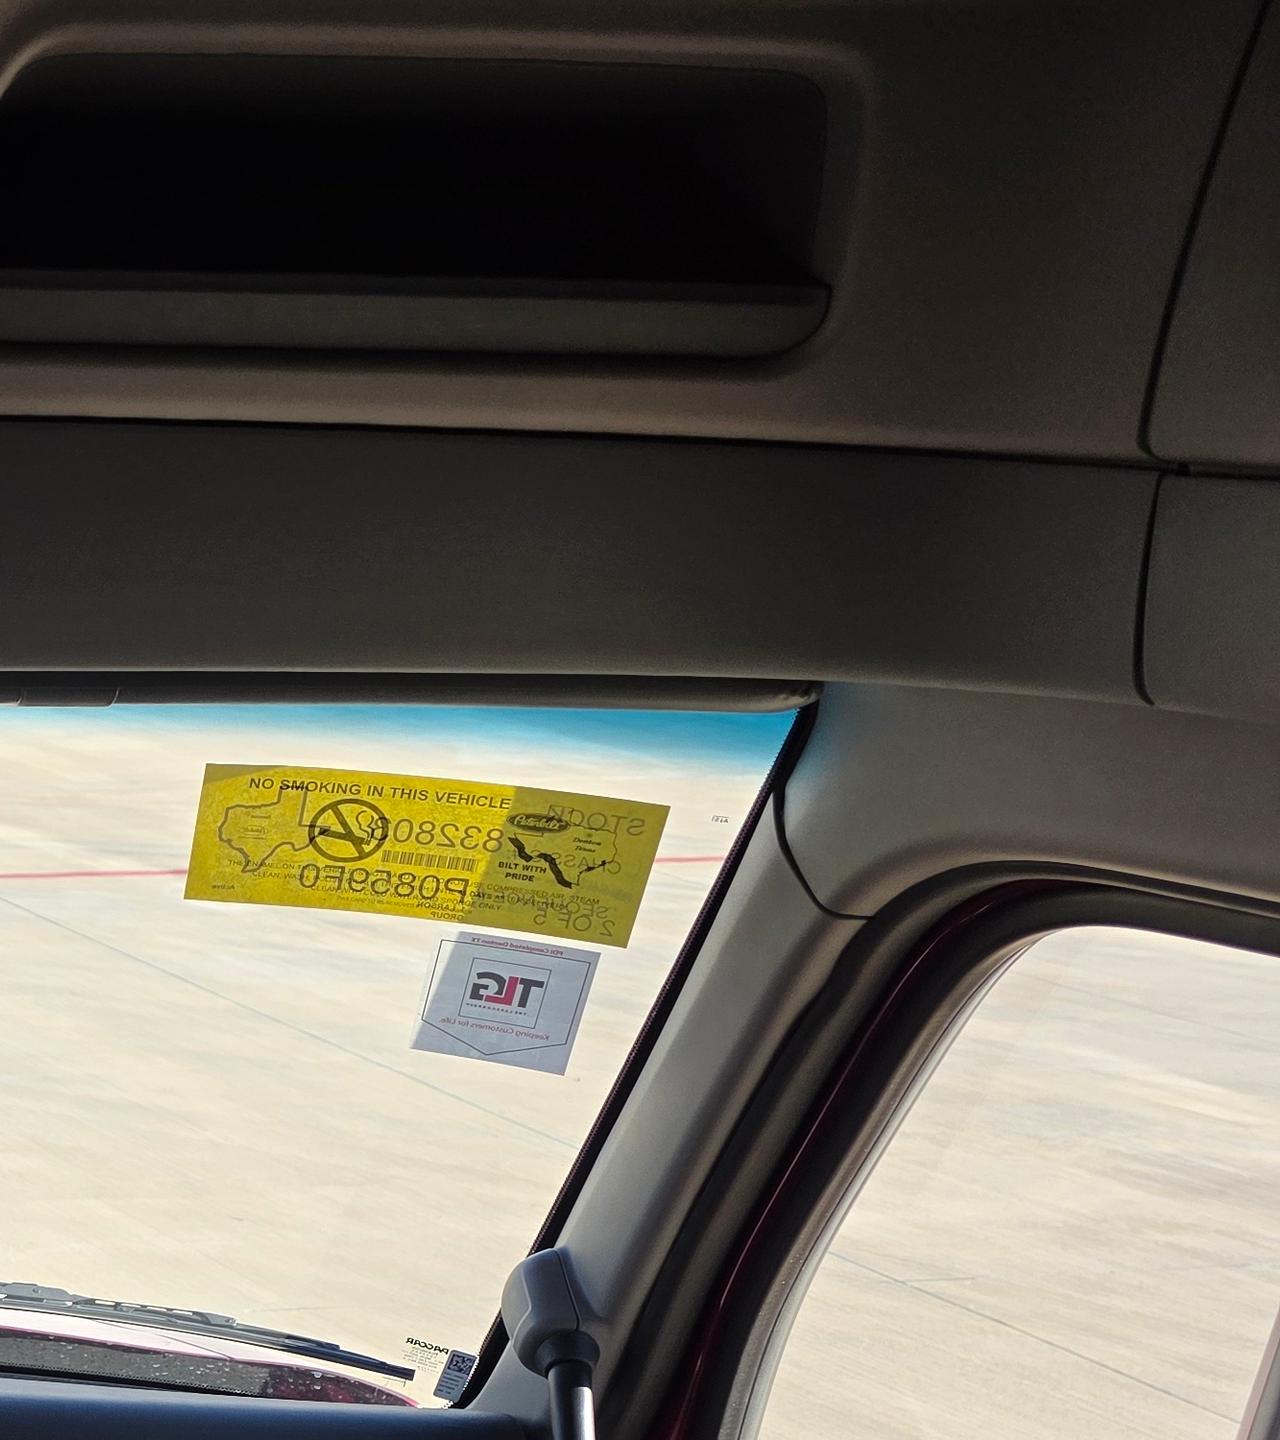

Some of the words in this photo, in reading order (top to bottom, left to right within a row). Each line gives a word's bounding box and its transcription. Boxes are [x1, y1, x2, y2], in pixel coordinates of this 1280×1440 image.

[249, 777, 275, 790] NO
[279, 779, 362, 796] SMOKING
[366, 785, 385, 798] IN
[390, 787, 429, 801] THIS
[434, 791, 512, 810] VEHICLE
[498, 861, 520, 871] BILT
[521, 863, 547, 874] WITH
[504, 872, 535, 882] PRIDE
